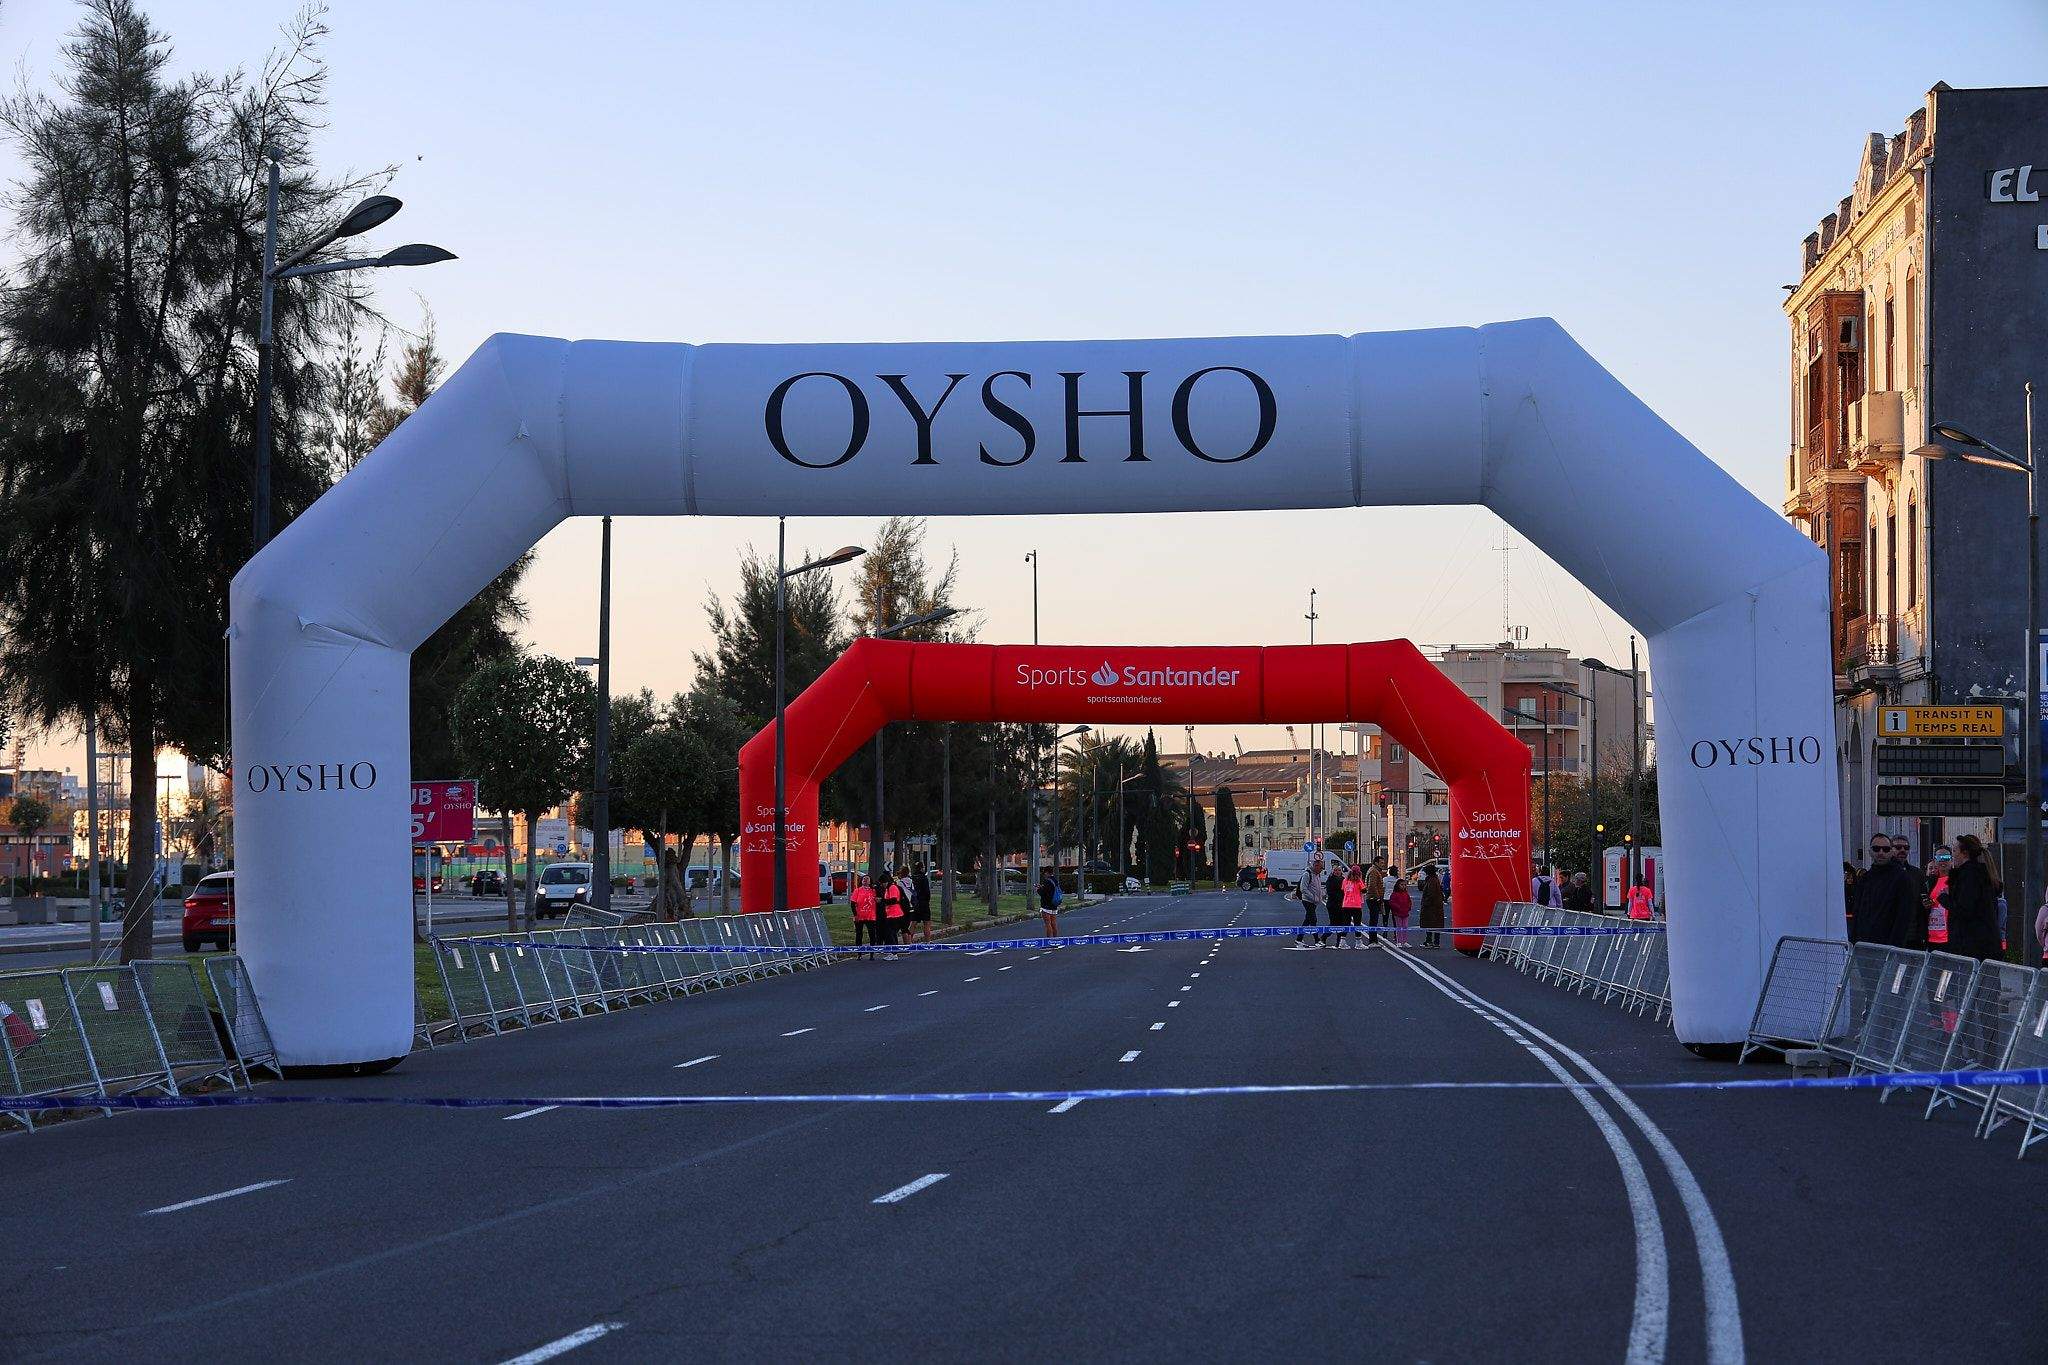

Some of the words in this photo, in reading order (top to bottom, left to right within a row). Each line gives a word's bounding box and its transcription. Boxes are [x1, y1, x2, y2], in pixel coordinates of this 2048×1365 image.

[1990, 165, 2040, 203] EL
[764, 365, 1278, 469] OYSHO
[1016, 663, 1088, 690] Sports
[1123, 666, 1241, 687] Santander
[1087, 695, 1162, 704] sportssantander.es
[1914, 710, 1971, 719] TRANSIT
[1976, 710, 1993, 719] EN
[1914, 723, 1958, 733] TEMPS
[1962, 723, 1996, 733] REAL
[1690, 735, 1821, 769] OYSHO
[248, 761, 377, 793] OYSHO
[443, 802, 472, 810] OYSHO
[757, 806, 790, 817] Spos
[1472, 811, 1506, 823] Sports
[754, 823, 805, 832] Santnder
[1470, 829, 1521, 838] Santander
